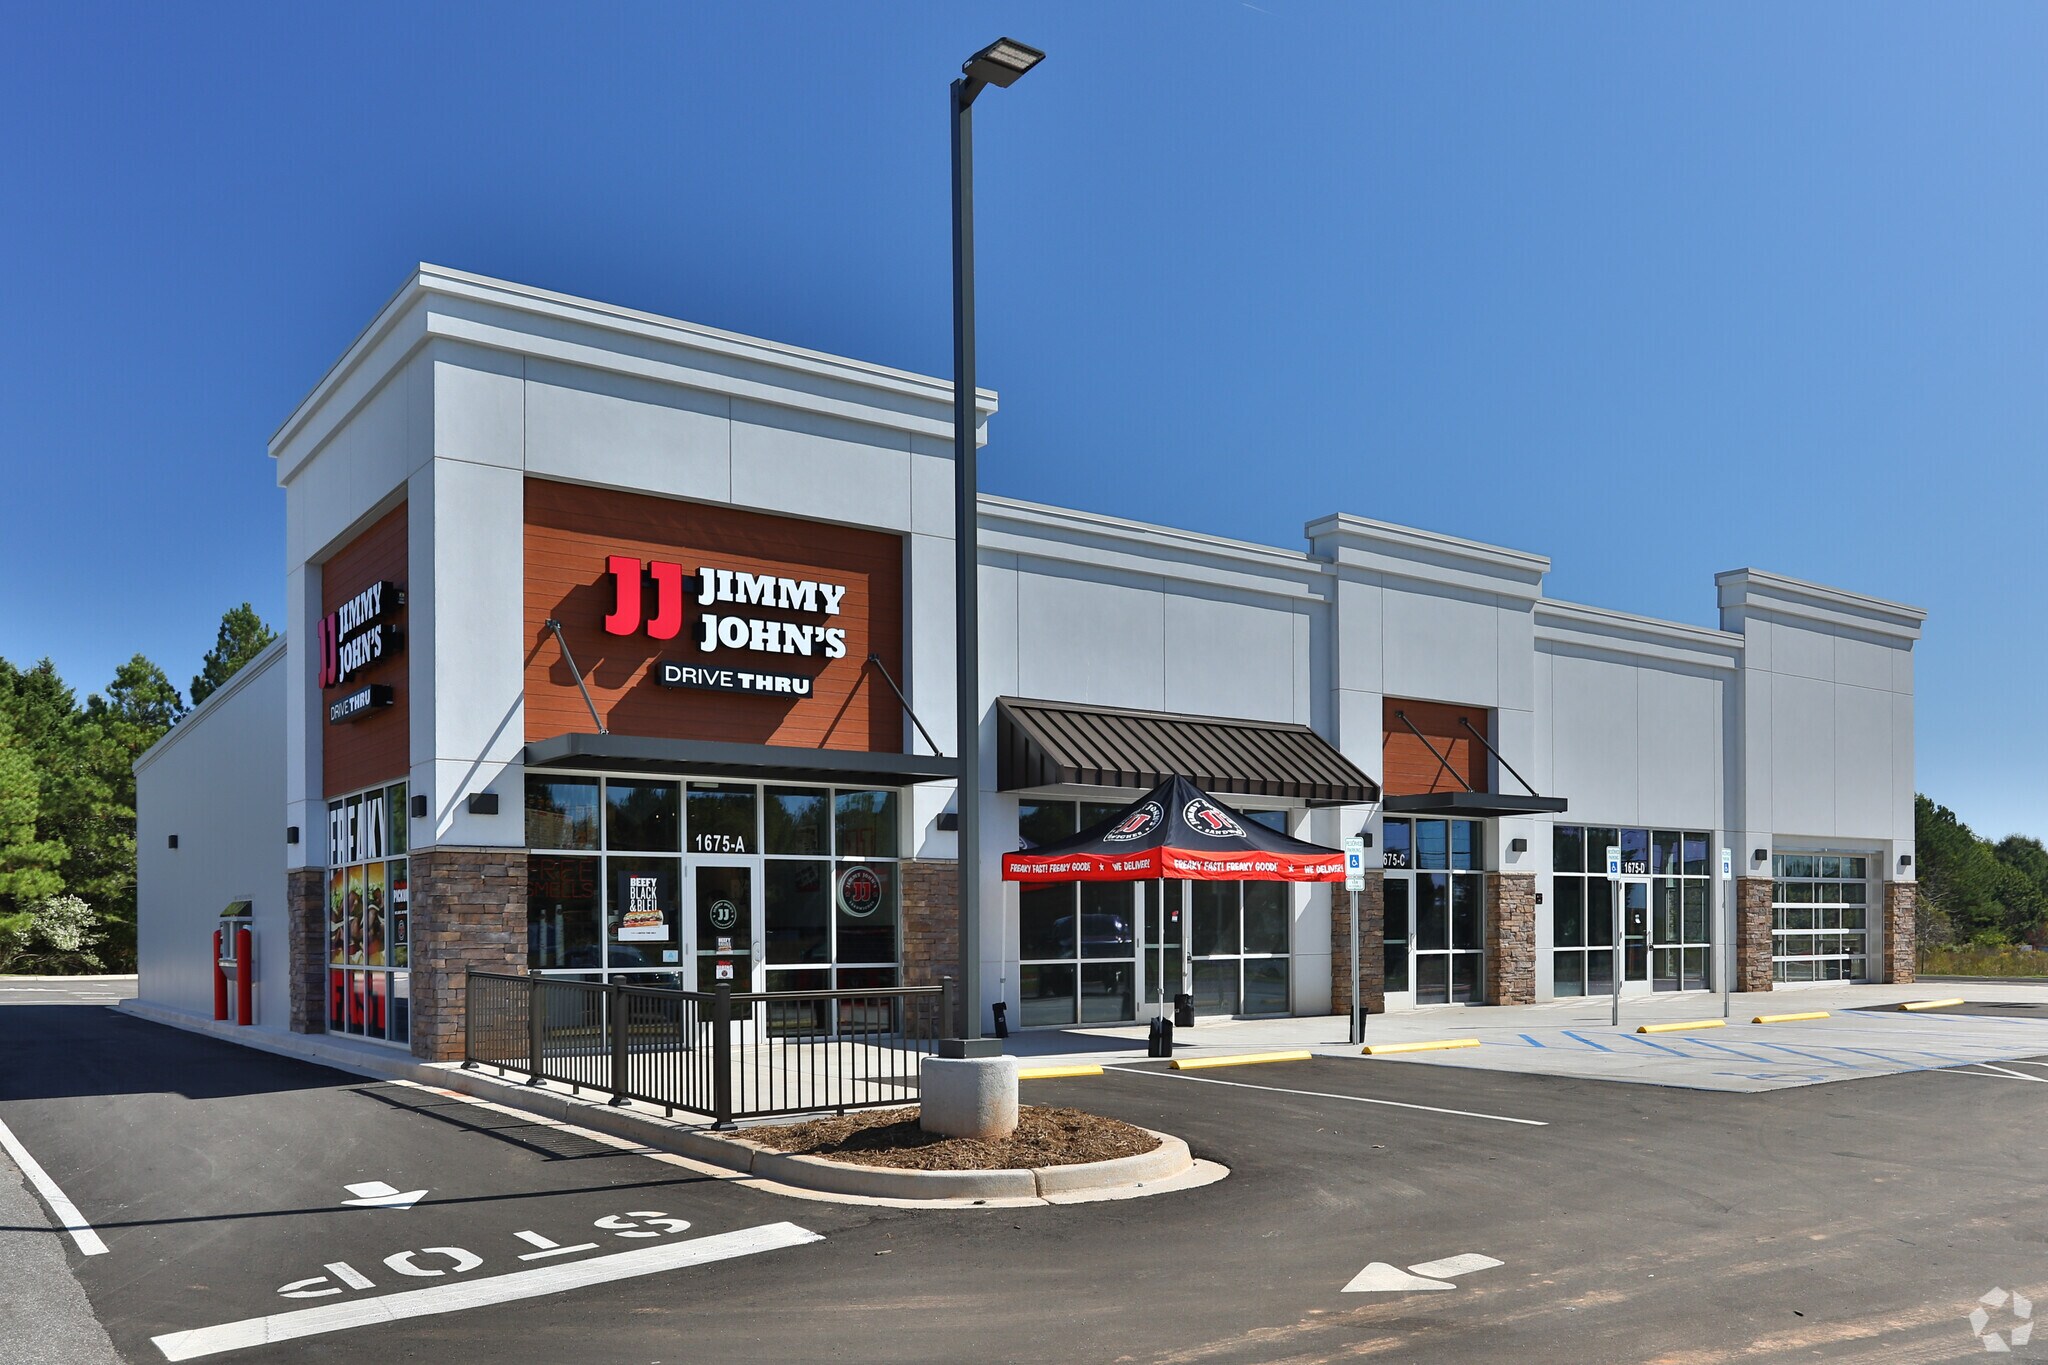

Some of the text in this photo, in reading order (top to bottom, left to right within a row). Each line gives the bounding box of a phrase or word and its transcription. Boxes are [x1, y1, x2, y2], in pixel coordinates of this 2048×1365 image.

[605, 555, 682, 640] JJ
[698, 567, 846, 615] JIMMY
[338, 580, 382, 643] JIMMY
[318, 612, 336, 689] JJ
[700, 613, 847, 659] JOHN'S
[339, 624, 382, 683] JOHN'S
[665, 665, 810, 695] DRIVE THRU
[330, 689, 371, 721] DRIVE THRU
[696, 833, 745, 853] 1675-A
[1010, 859, 1151, 873] FREAKY FAST! FREAKY GOOD! WE DELIVER!
[1174, 859, 1344, 874] FREAKY FAST! FREAKY GOOD! WE DELIVER!
[1383, 852, 1406, 867] 675-C
[1624, 862, 1646, 874] 1675-D
[630, 878, 657, 887] BEEFY
[630, 886, 657, 900] BLACK
[853, 882, 871, 902] JJ
[277, 1211, 691, 1298] STOP
